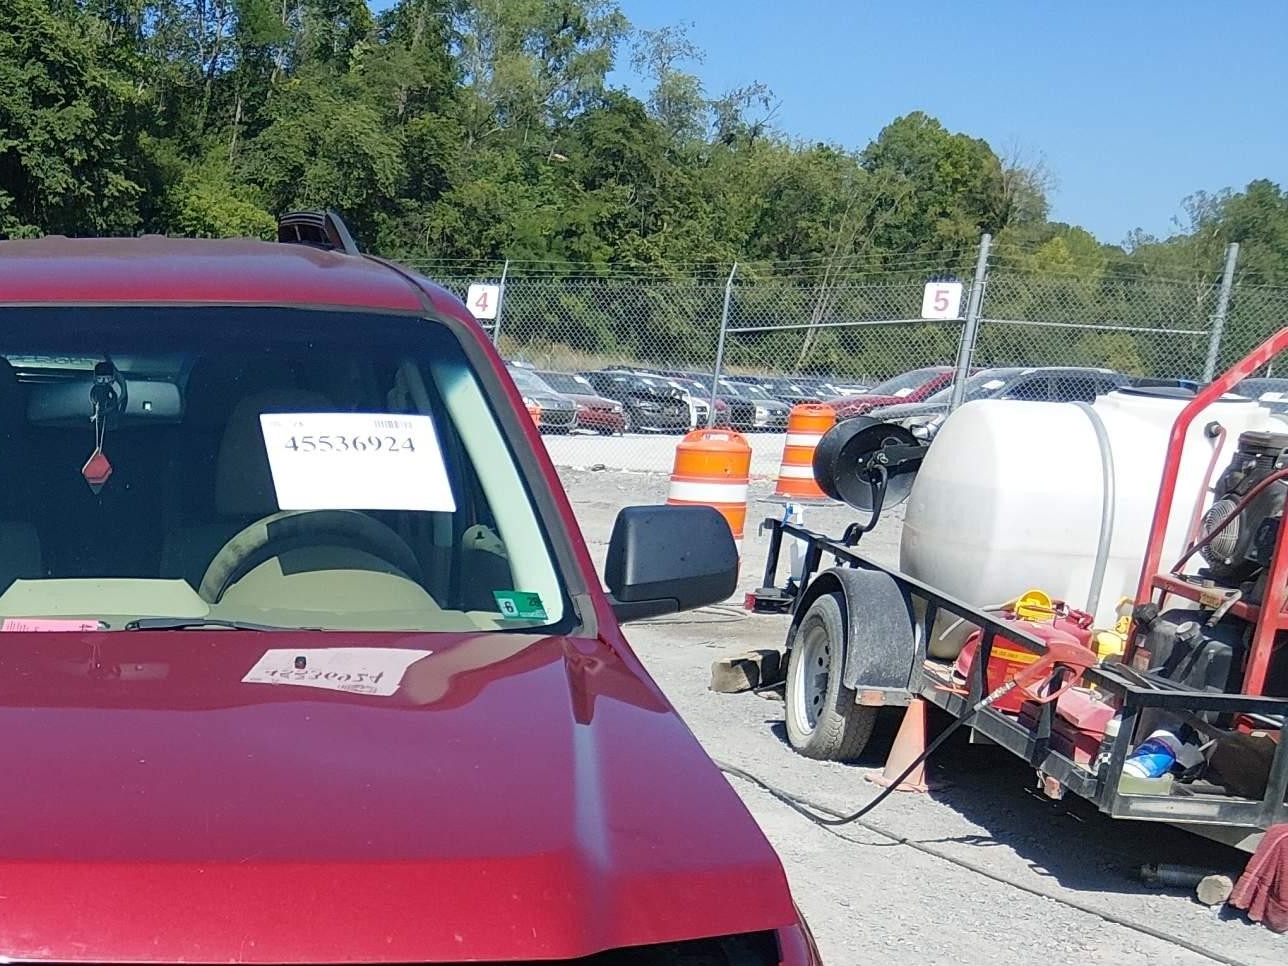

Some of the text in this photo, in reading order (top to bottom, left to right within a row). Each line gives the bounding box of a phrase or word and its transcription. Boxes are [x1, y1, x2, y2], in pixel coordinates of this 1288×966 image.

[475, 292, 488, 312] 4
[933, 290, 950, 312] 5
[285, 435, 416, 453] 45536924
